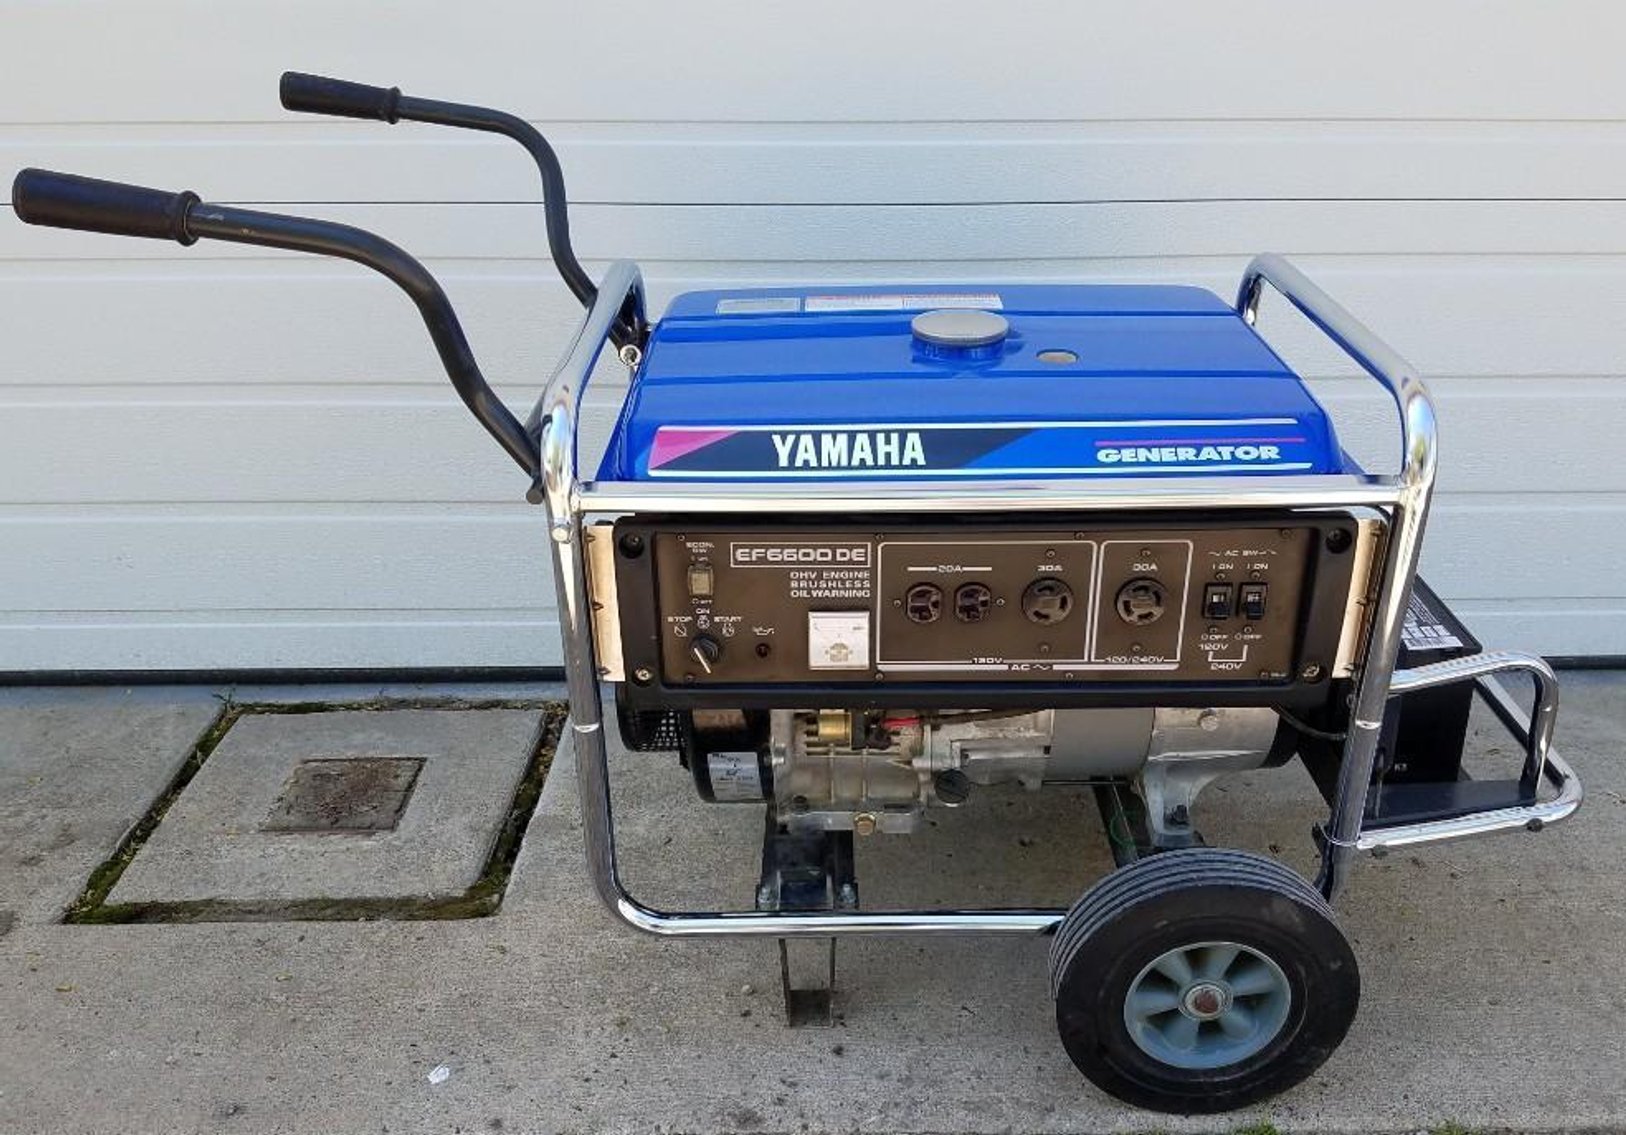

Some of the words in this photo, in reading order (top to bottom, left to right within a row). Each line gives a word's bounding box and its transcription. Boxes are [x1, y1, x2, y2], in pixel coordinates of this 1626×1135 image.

[771, 432, 926, 467] YAMAHA
[1096, 446, 1282, 463] GENERATOR
[735, 548, 832, 562] EF6600
[836, 548, 866, 561] DE
[938, 565, 963, 573] 20A
[1132, 563, 1158, 571] 30A
[790, 571, 818, 580] OHV
[822, 571, 871, 580] ENGINE
[791, 580, 871, 588] BRUSHLESS
[790, 589, 811, 598] OIL
[811, 589, 871, 598] WARNING
[1210, 662, 1243, 671] 240V
